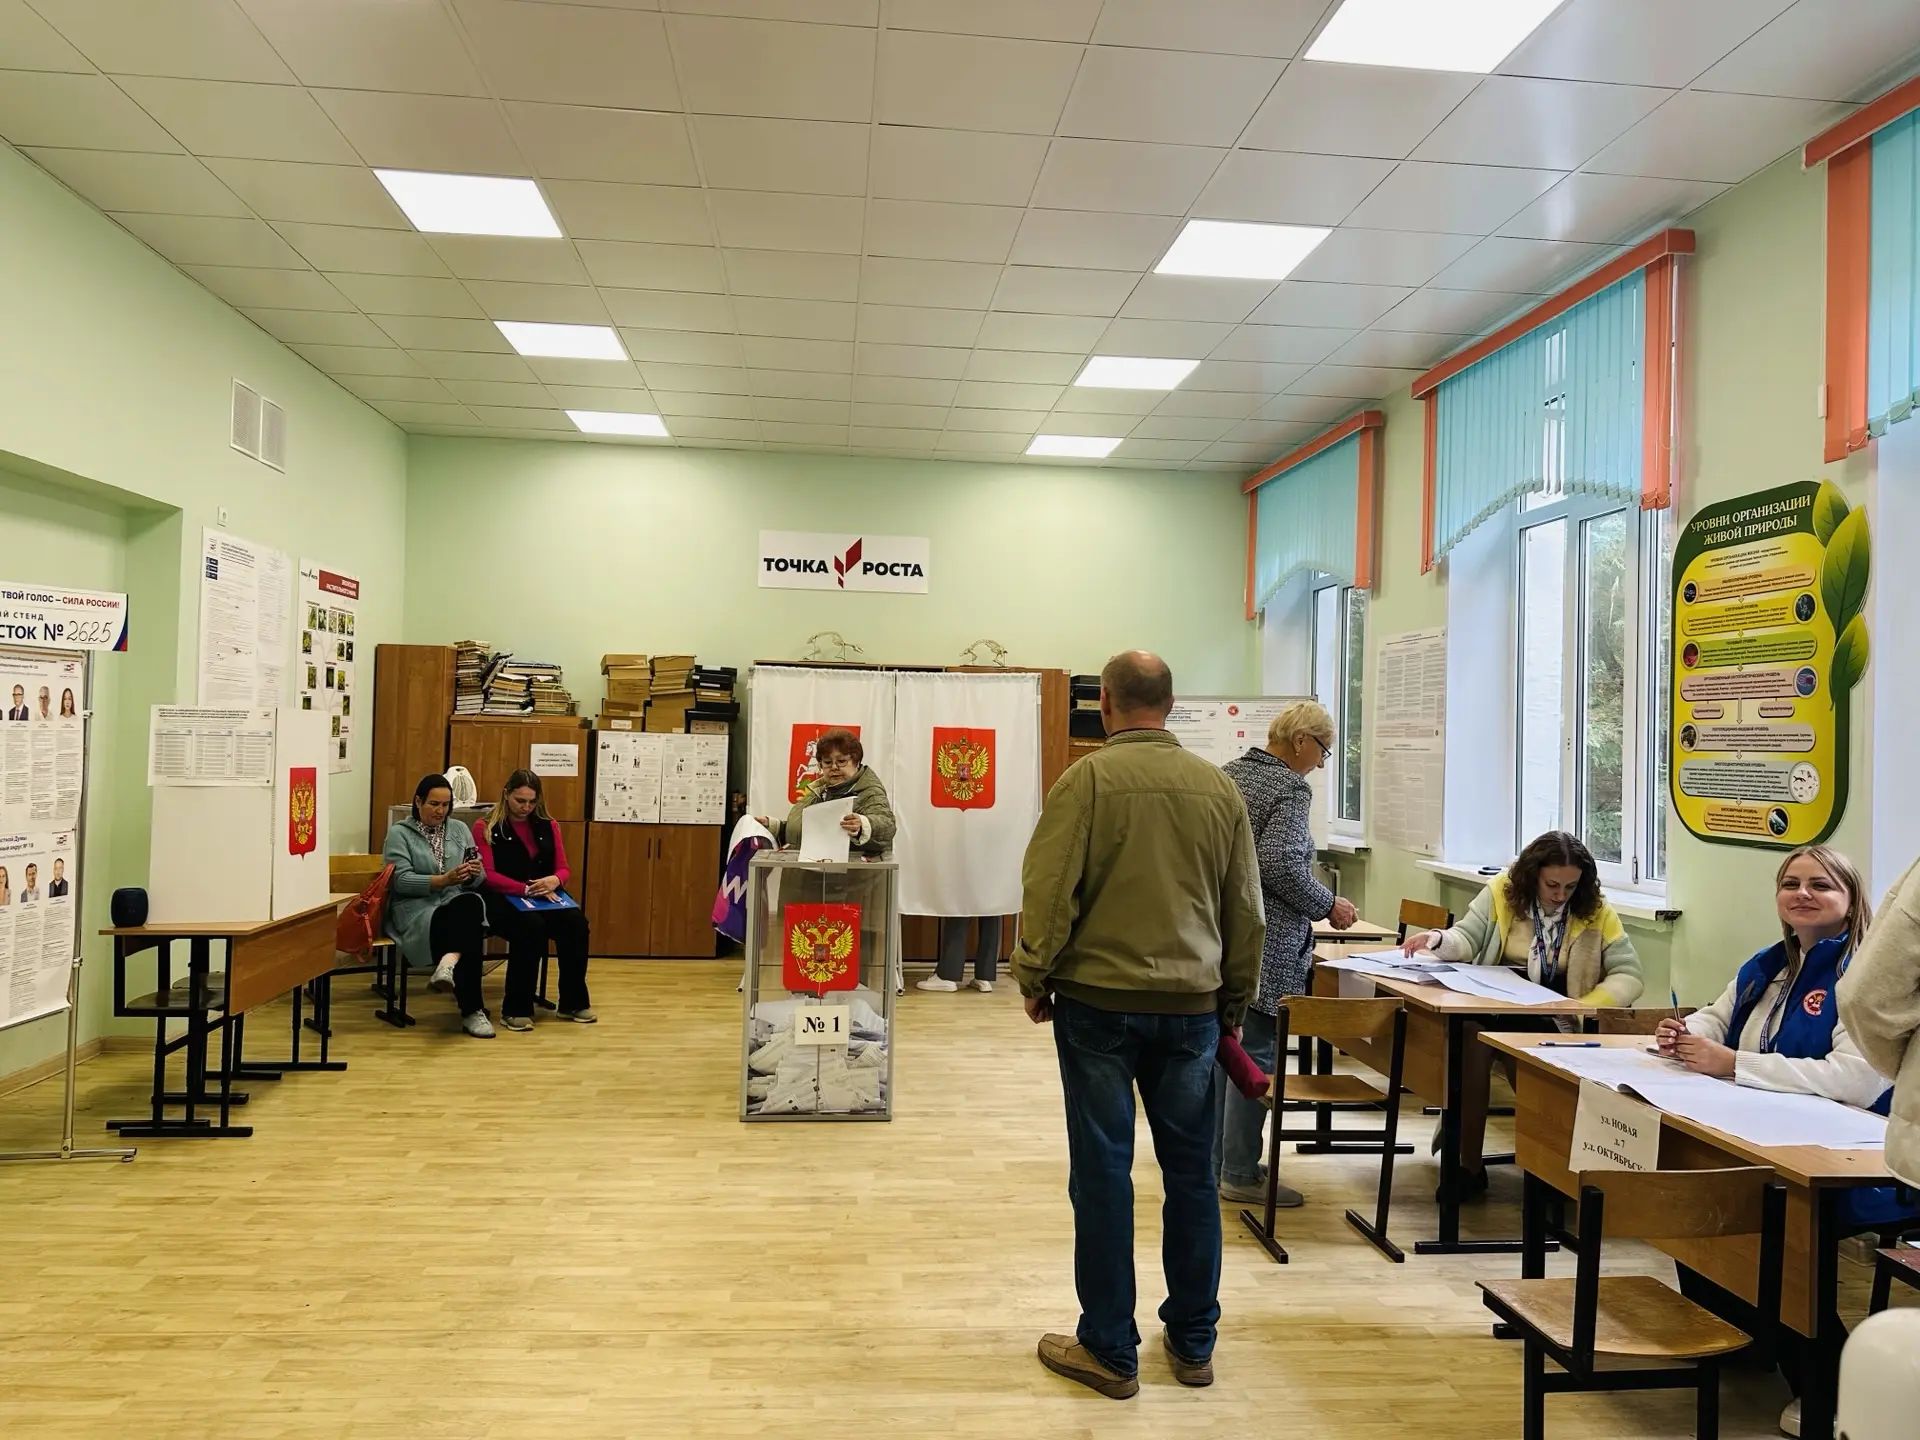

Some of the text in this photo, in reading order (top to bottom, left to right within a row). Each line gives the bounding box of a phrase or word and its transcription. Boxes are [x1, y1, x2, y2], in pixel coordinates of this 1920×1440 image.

[1691, 494, 1811, 533] УРОВНИ ОРГАНИЗАЦИИ
[1703, 515, 1798, 545] ЖИВОЙ ПРИРОДЫ
[763, 557, 924, 577] ТОЧКА РОСТА
[1, 590, 24, 600] ТВОЙ
[26, 593, 54, 603] ГОЛОС
[62, 596, 85, 606] СИЛА
[86, 599, 120, 608] РОССИИ!
[13, 611, 44, 621] СТЕНД
[43, 623, 64, 641] №
[66, 620, 114, 643] 2625
[802, 1015, 840, 1033] № 1
[1612, 1118, 1638, 1138] НОВАЯ
